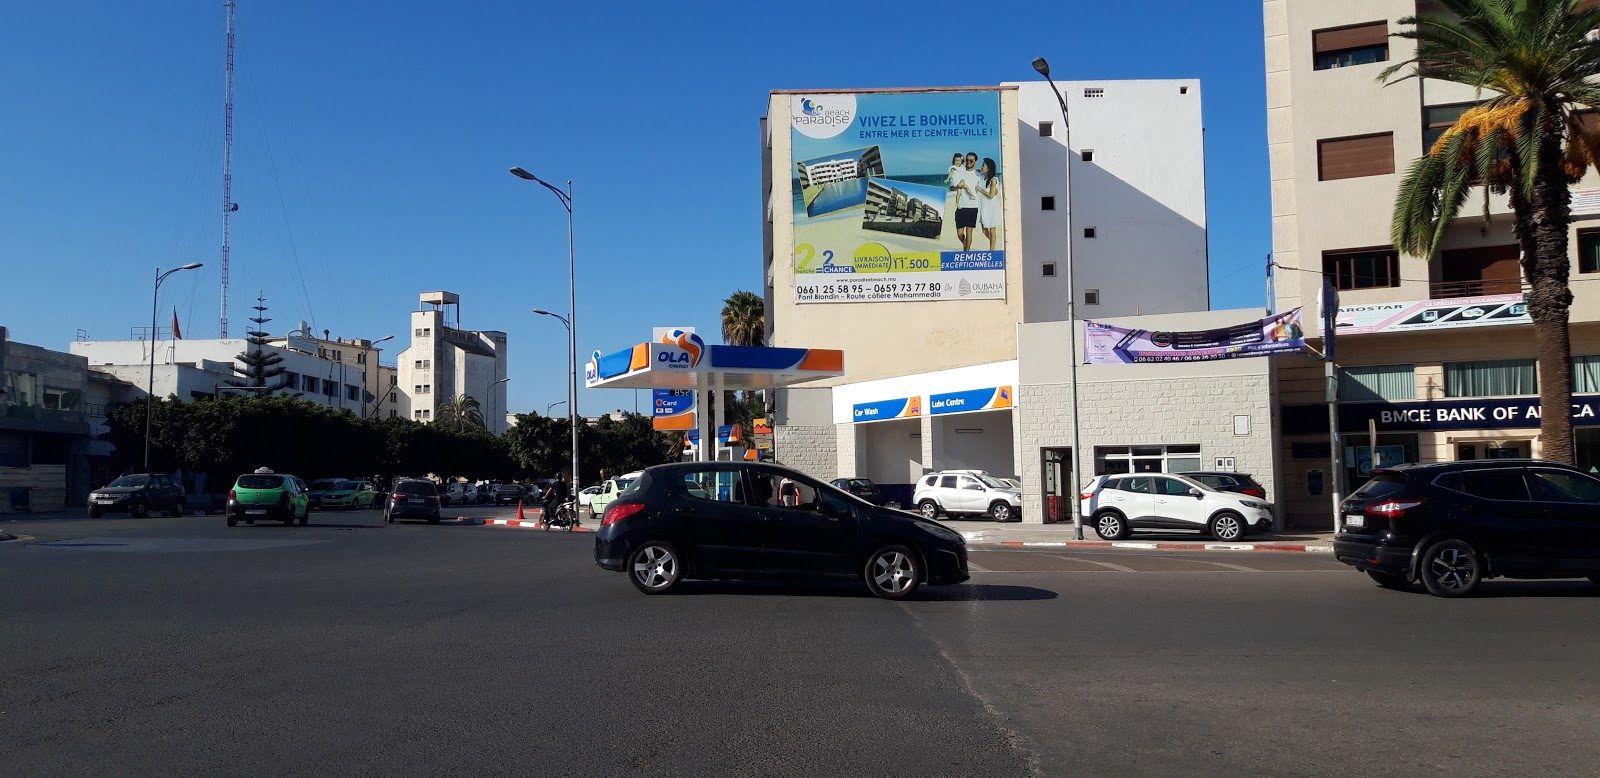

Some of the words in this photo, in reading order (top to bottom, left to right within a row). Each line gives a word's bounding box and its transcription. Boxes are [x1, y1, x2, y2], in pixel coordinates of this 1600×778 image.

[859, 115, 897, 128] VIVEZ
[900, 115, 916, 127] LE
[920, 113, 988, 127] BONHEUR,
[859, 130, 888, 139] ENTRE
[891, 129, 910, 138] MER
[912, 129, 923, 138] ET
[924, 128, 988, 137] CENTRE-VILLE
[854, 255, 889, 263] LIVRAISON
[954, 252, 992, 262] REMISES
[893, 258, 929, 270] 11.500
[941, 260, 1003, 269] EXCEPTIONNELLES
[796, 285, 819, 295] 0661
[822, 285, 835, 294] 25
[837, 285, 849, 294] 58
[852, 284, 863, 293] 95
[873, 284, 897, 293] 0659
[900, 283, 912, 292] 73
[912, 283, 926, 292] 77
[929, 282, 941, 291] 80
[893, 291, 941, 299] Mohammedia
[657, 351, 690, 363] OLA
[931, 399, 945, 408] Lube
[945, 398, 965, 407] Centre
[864, 407, 879, 416] Wash
[1381, 409, 1431, 424] BMCE
[1436, 407, 1486, 422] BANK
[1493, 406, 1519, 420] OF
